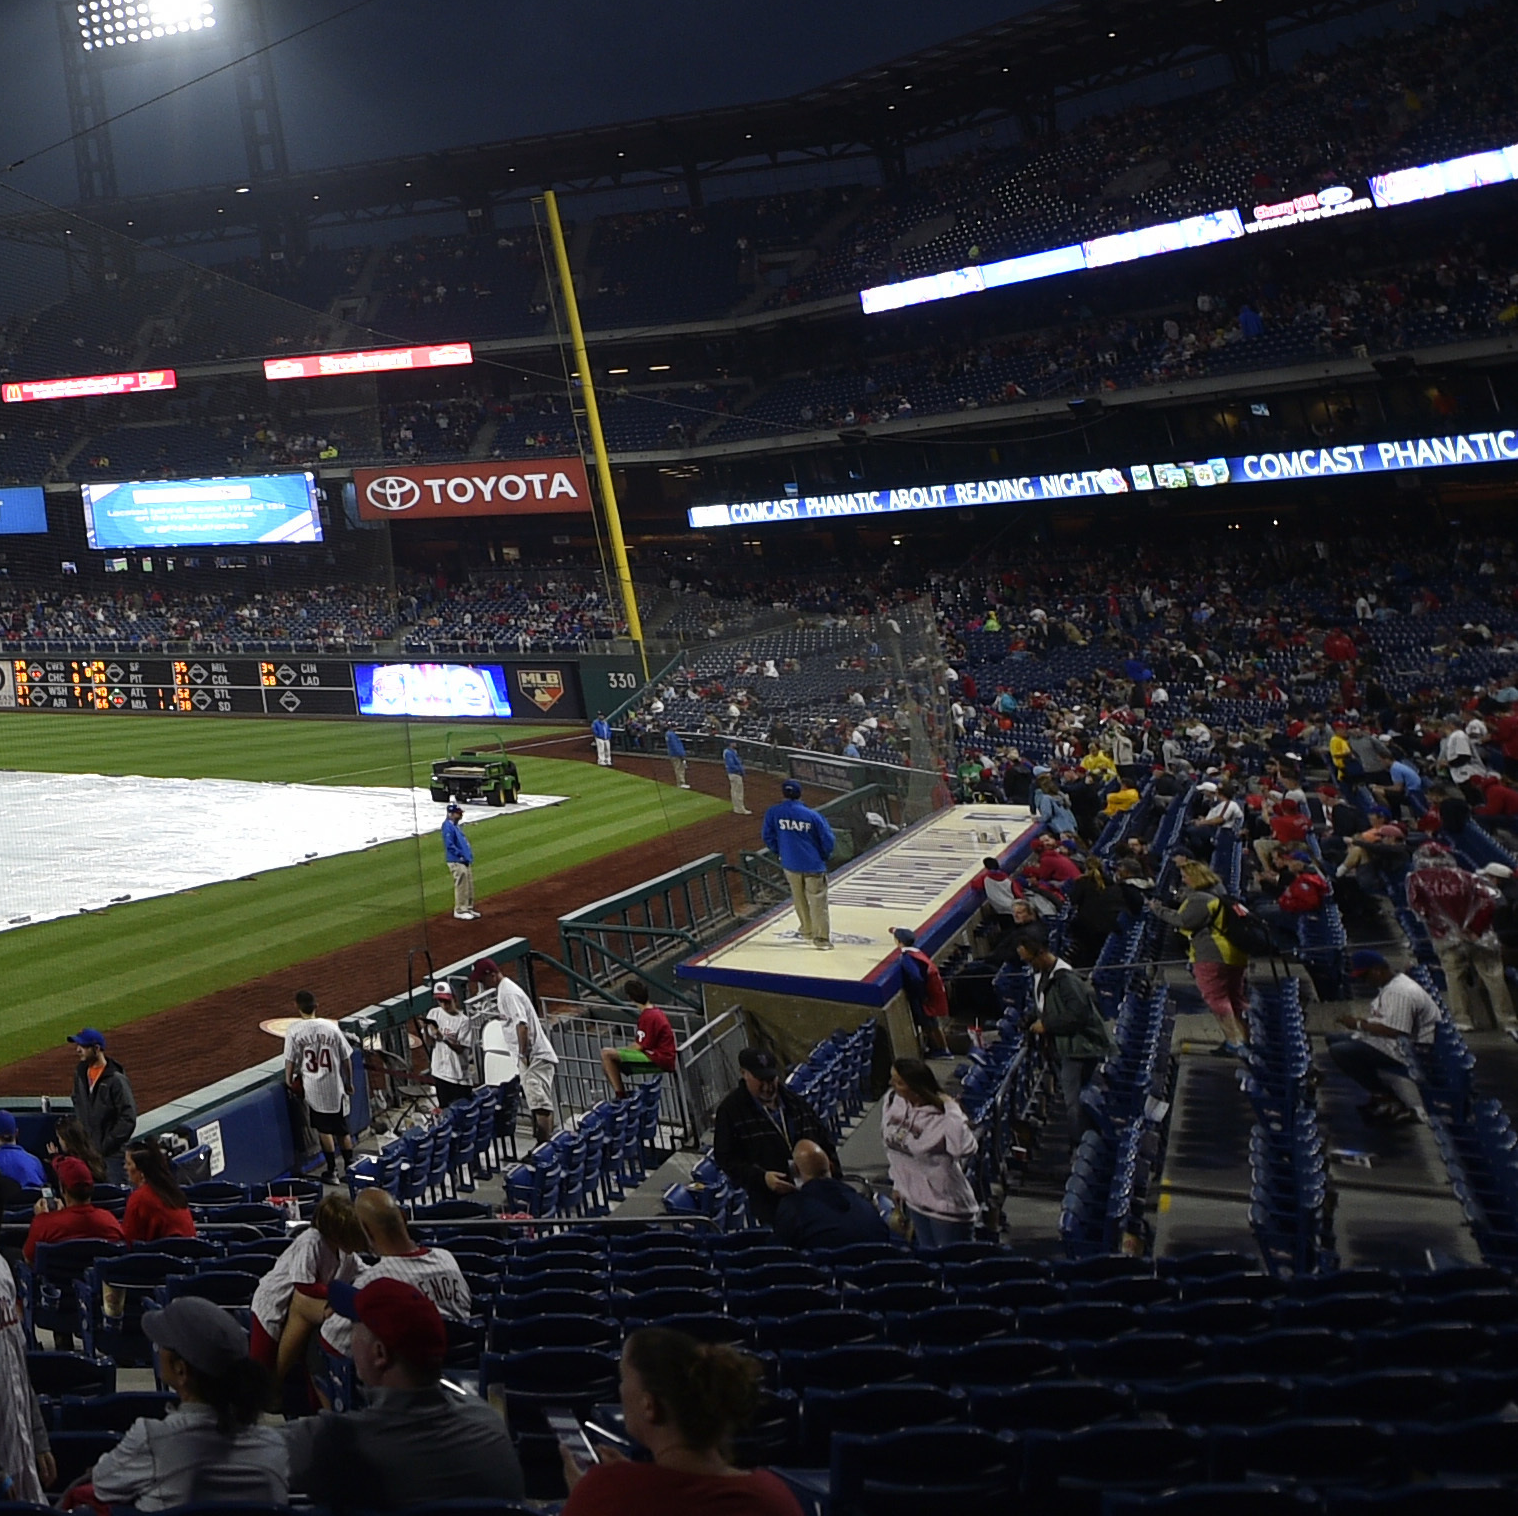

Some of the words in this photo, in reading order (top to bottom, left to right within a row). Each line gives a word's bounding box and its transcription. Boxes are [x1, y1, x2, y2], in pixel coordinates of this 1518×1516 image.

[1254, 199, 1296, 224] Cherry
[1295, 193, 1320, 212] Hill
[1244, 197, 1373, 234] winnerford.com
[1243, 443, 1366, 480] COMCAST
[1378, 430, 1518, 469] PHANATIC
[424, 472, 578, 504] TOYOTA
[731, 499, 799, 524] COMCAST
[805, 492, 884, 517] PHANATIC
[889, 485, 948, 510] ABOUT
[955, 478, 1035, 504] READING
[1040, 470, 1102, 497] NIGHT
[45, 661, 64, 671] CWS
[129, 662, 140, 671] SF
[301, 664, 317, 674] CIN
[48, 673, 65, 683] CHC
[130, 674, 143, 683] PIT
[212, 675, 231, 685] COL
[301, 676, 320, 686] LAD
[520, 672, 560, 684] MLB
[608, 673, 637, 689] 330
[48, 686, 68, 696] WSH
[131, 688, 146, 698] ATL
[214, 689, 231, 699] STL
[218, 701, 232, 711] SD
[778, 818, 813, 832] STAFF
[304, 1048, 333, 1073] 34
[418, 1276, 461, 1304] ENCE
